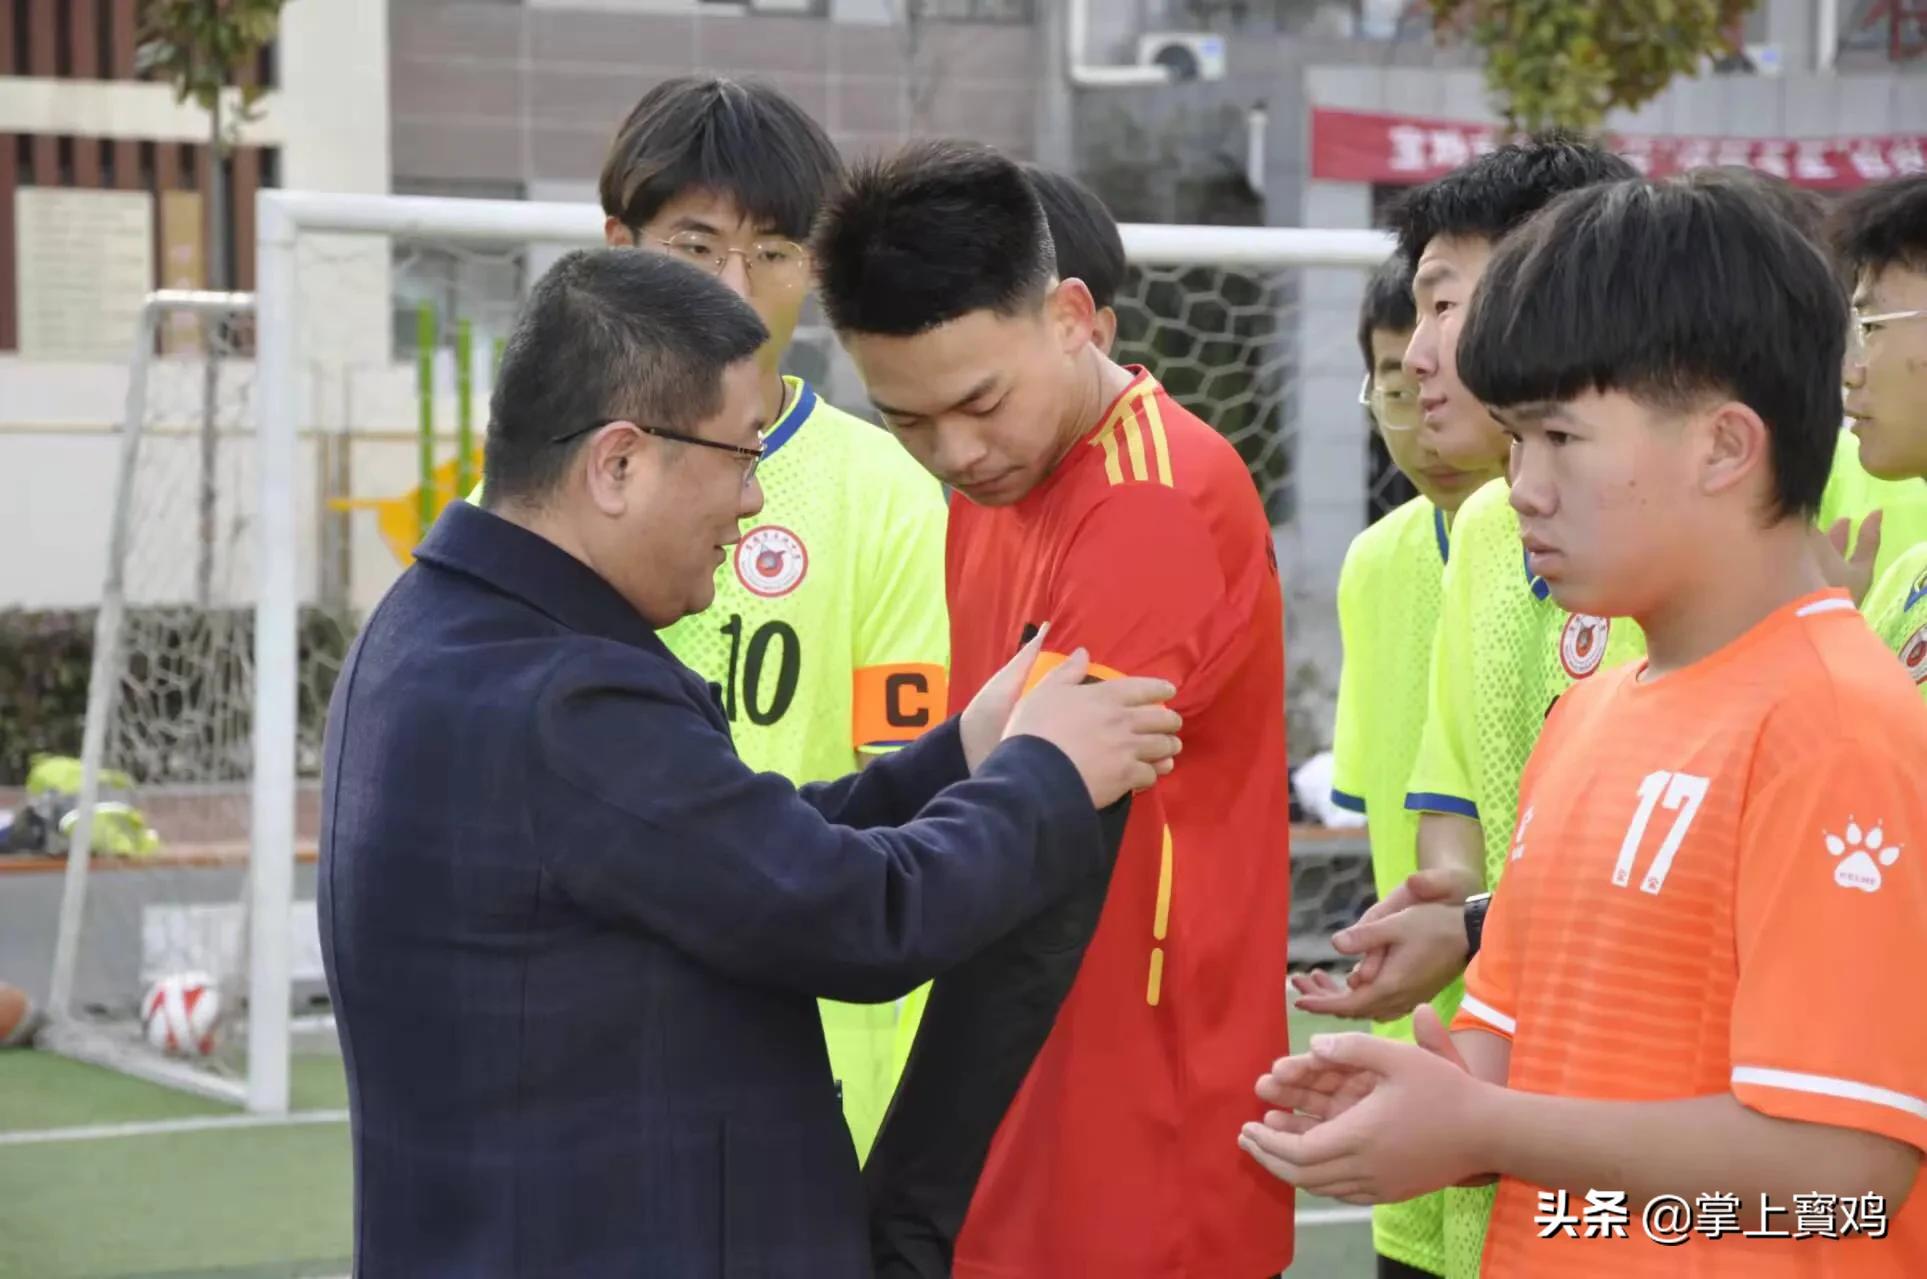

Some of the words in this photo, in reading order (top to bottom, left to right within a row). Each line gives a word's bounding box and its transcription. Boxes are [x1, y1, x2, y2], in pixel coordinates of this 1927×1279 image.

[720, 613, 800, 726] 10
[885, 672, 929, 727] C
[1611, 770, 1709, 894] 17
